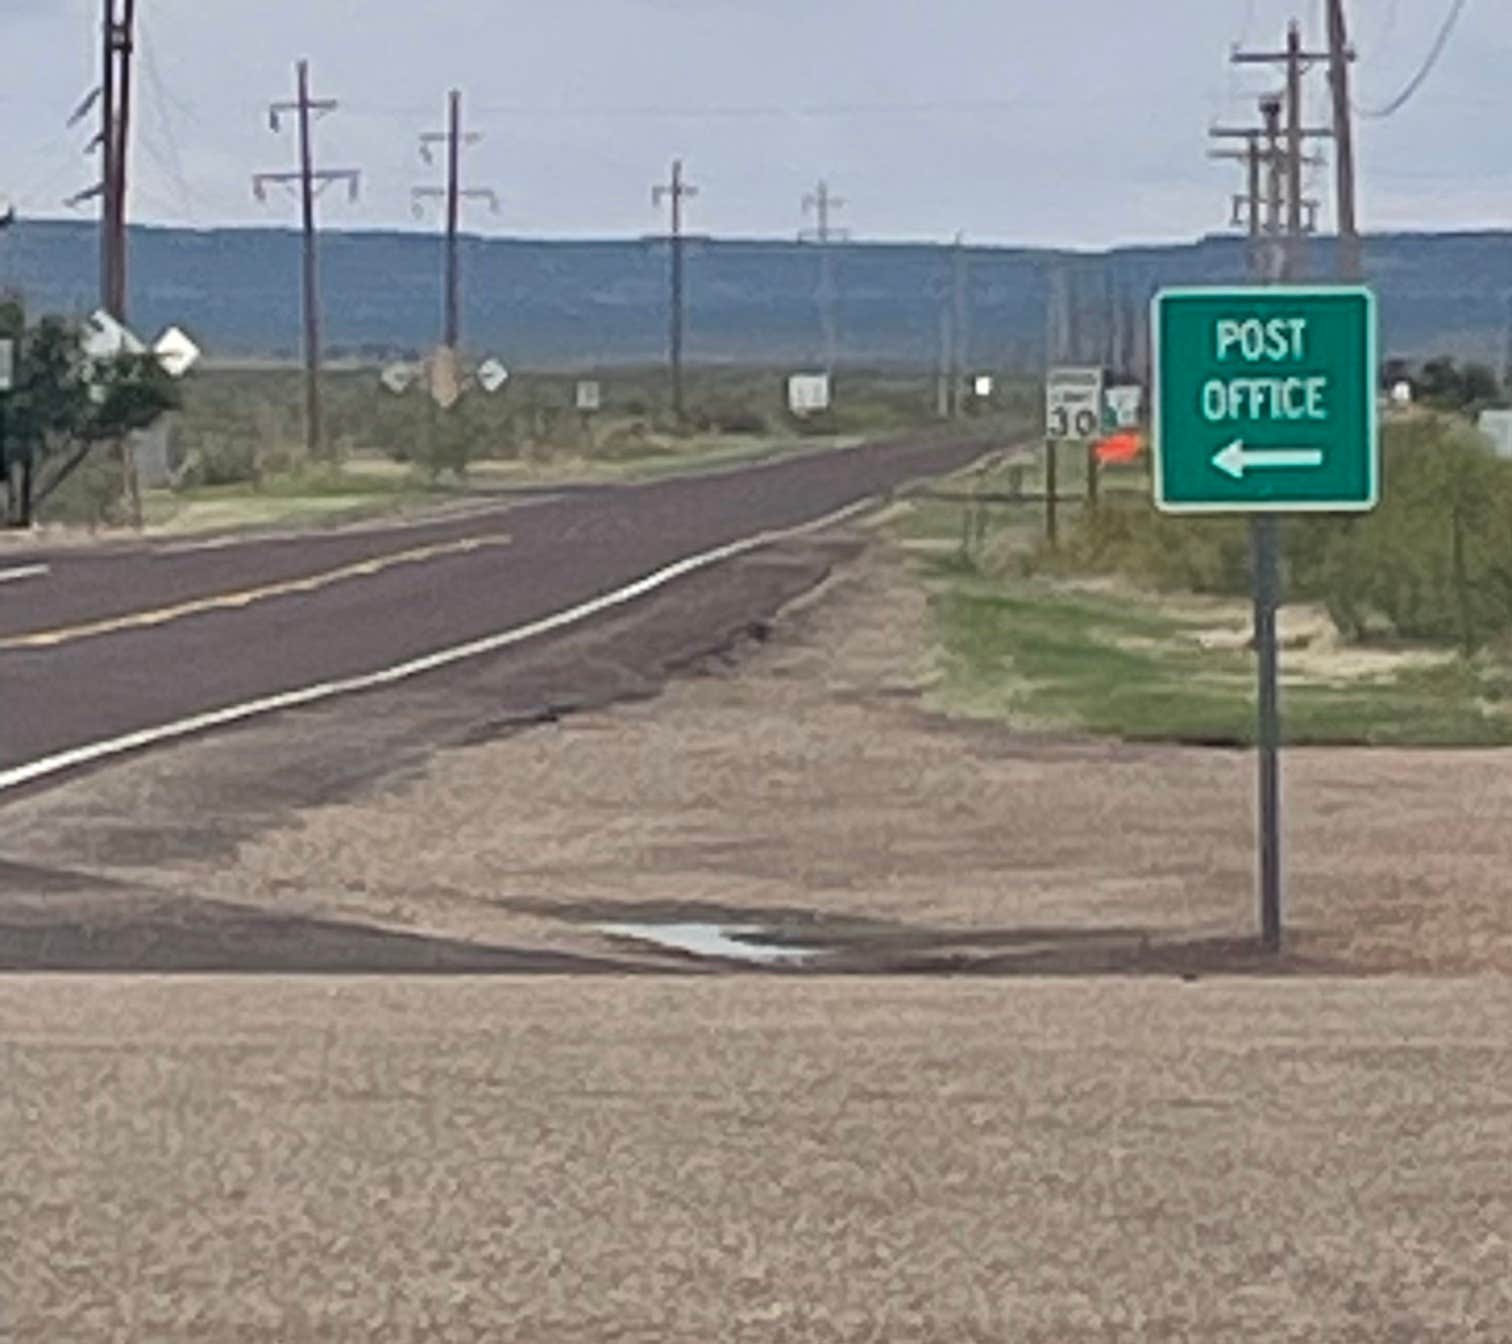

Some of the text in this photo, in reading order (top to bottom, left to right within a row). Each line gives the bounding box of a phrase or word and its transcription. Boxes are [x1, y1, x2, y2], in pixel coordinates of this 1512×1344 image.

[1216, 318, 1306, 362] POST
[1202, 376, 1328, 422] OFFICE
[1048, 406, 1097, 437] 30
